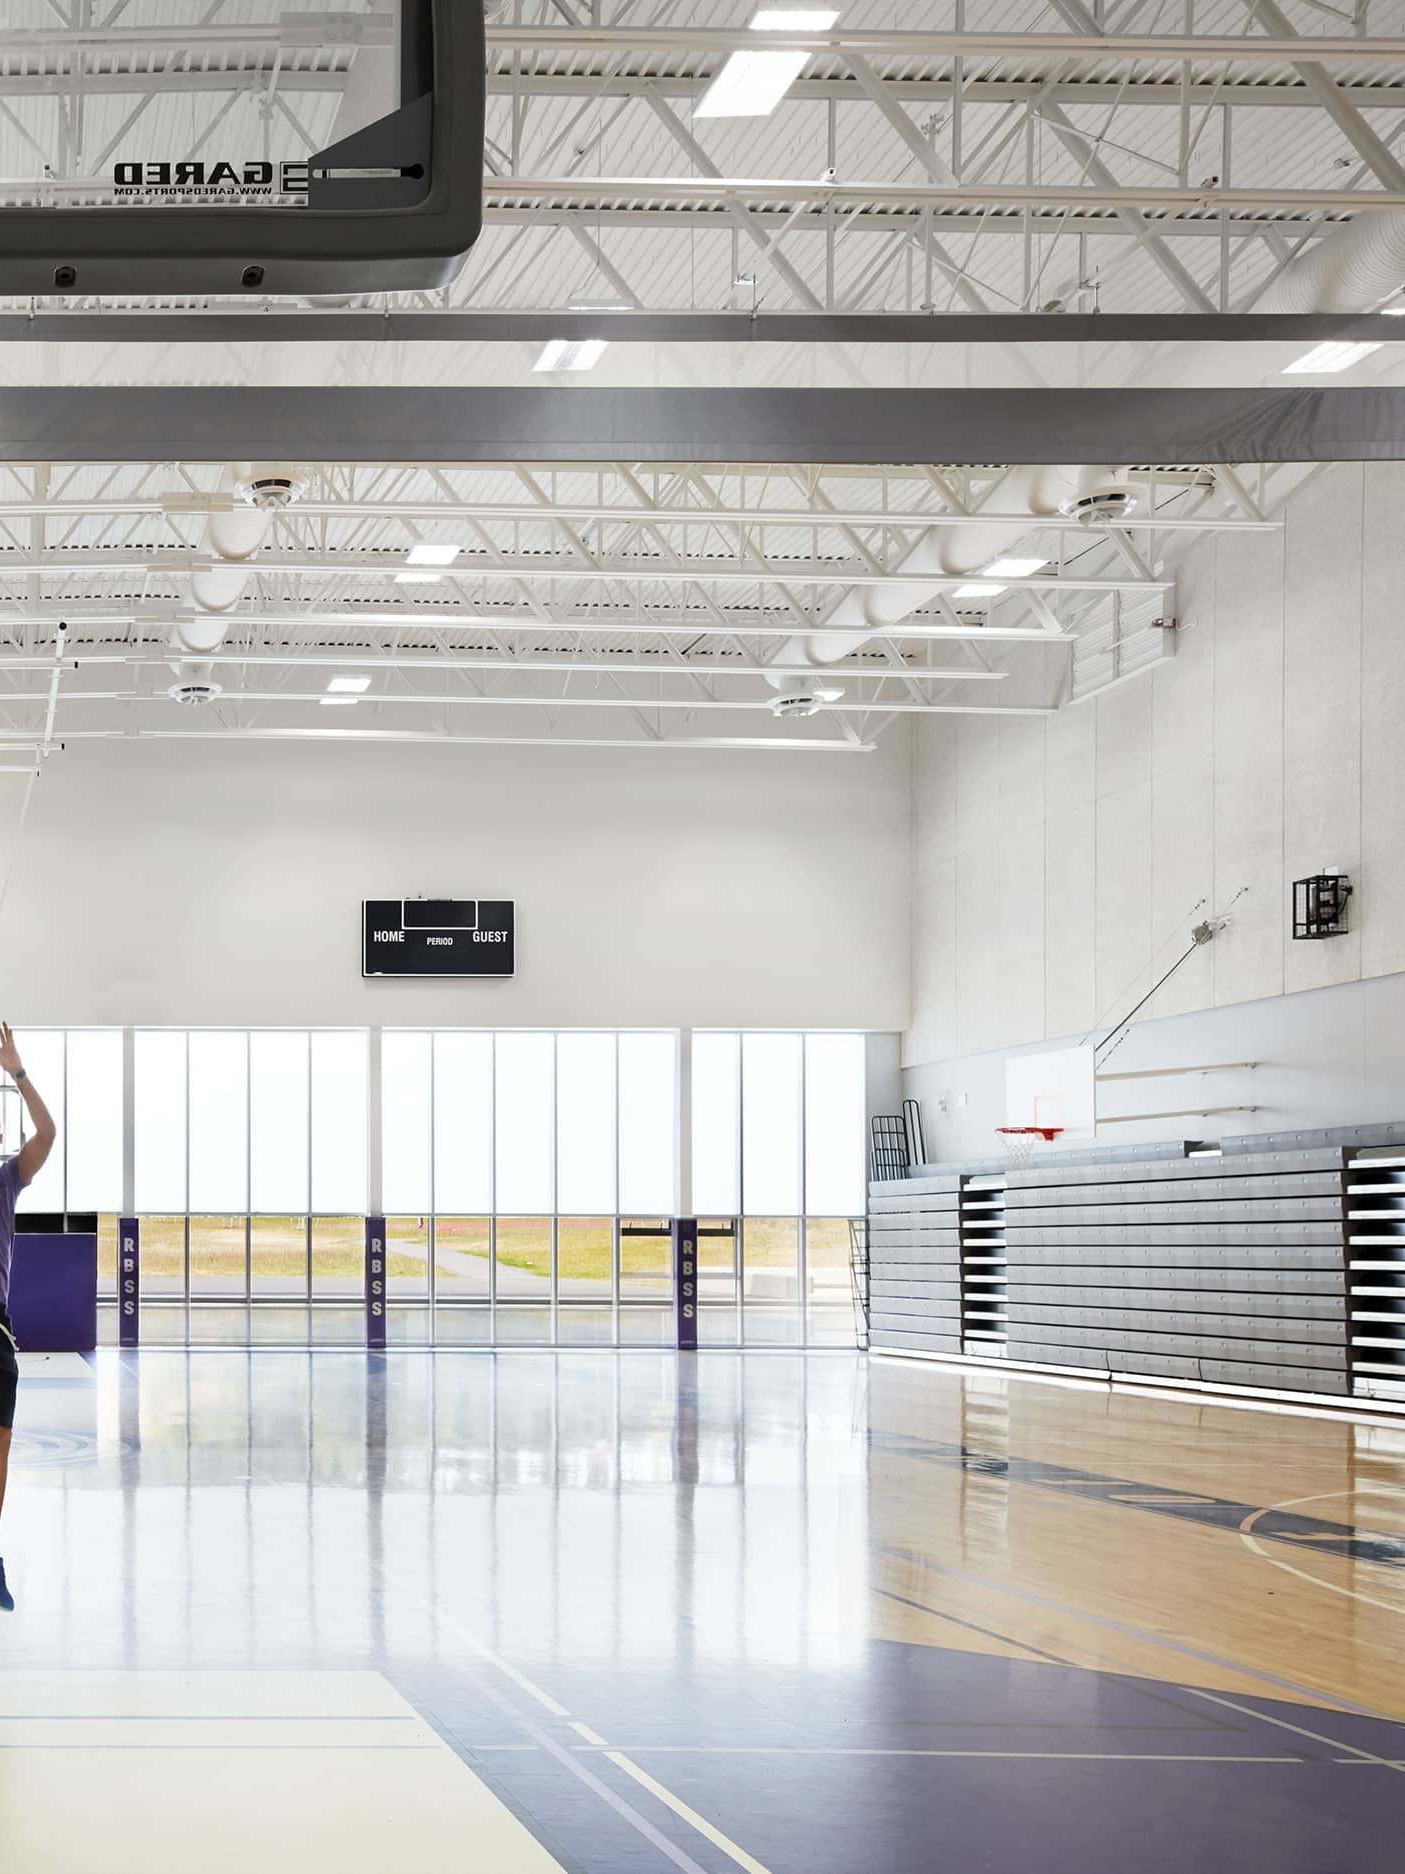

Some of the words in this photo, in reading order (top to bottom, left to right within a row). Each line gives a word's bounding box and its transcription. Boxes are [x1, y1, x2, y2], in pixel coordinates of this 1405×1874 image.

[373, 931, 405, 942] HOME
[426, 937, 454, 946] PERIOD
[472, 931, 508, 943] GUEST
[123, 1237, 135, 1315] RBSS
[371, 1238, 382, 1316] RBSS
[682, 1239, 694, 1318] RBSS
